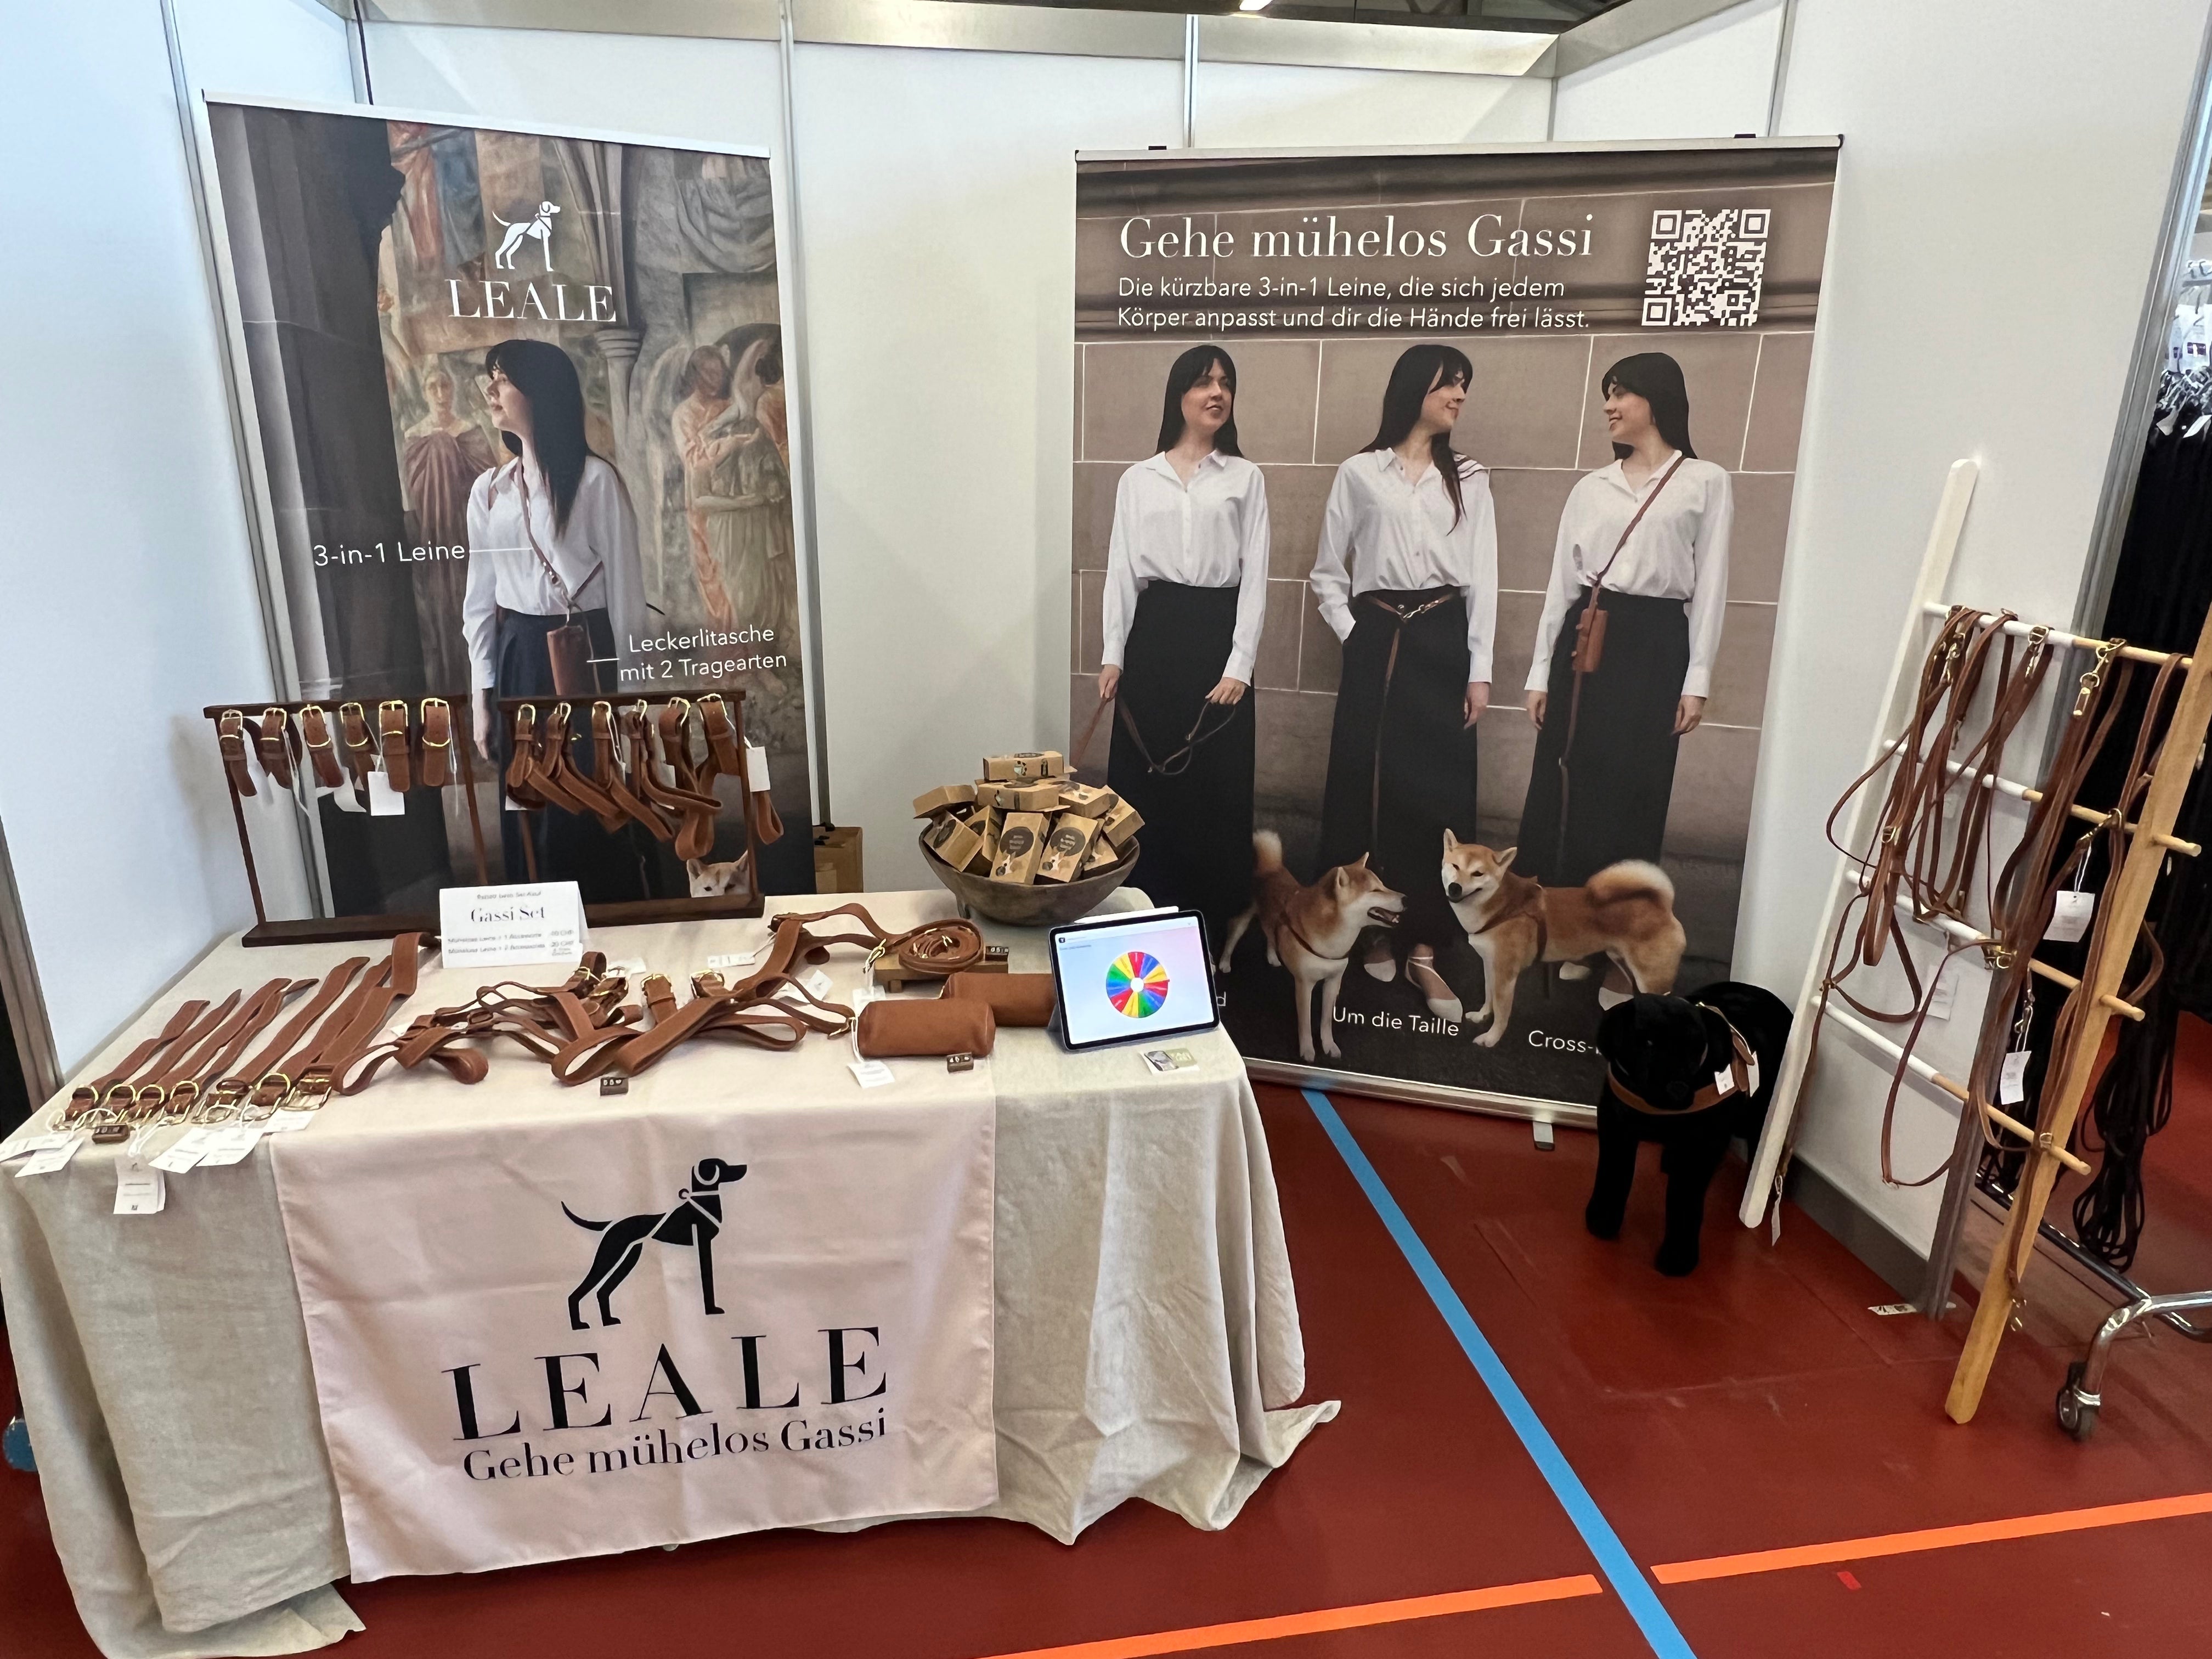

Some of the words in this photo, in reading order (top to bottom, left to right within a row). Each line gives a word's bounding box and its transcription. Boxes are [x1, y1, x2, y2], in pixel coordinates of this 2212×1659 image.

[1120, 217, 1234, 258] Gehe
[1250, 215, 1447, 258] mühelos
[1468, 213, 1594, 257] Gassi
[444, 279, 617, 322] LEALE
[1119, 276, 1153, 296] Die
[1161, 276, 1251, 297] kürzbare
[1259, 276, 1317, 297] 3-in-1
[1328, 276, 1392, 300] Leine,
[1399, 275, 1434, 297] die
[1441, 276, 1484, 297] sich
[1489, 275, 1565, 303] jedem
[1118, 307, 1189, 331] Körper
[1195, 309, 1277, 332] anpasst
[1283, 306, 1324, 327] und
[1331, 306, 1363, 328] dir
[1367, 306, 1402, 328] die
[1410, 307, 1484, 328] Hände
[1490, 306, 1527, 328] frei
[1535, 307, 1590, 328] lässt.
[313, 542, 385, 566] 3-in-1
[398, 540, 465, 562] Leine
[629, 624, 774, 653] Leckerlitasche
[620, 663, 655, 681] mit
[660, 659, 673, 679] 2
[678, 654, 787, 679] Tragearten
[471, 906, 514, 922] Gassi
[520, 905, 545, 920] Set
[1333, 1006, 1364, 1025] Um
[1372, 1011, 1403, 1030] die
[1408, 1015, 1459, 1036] Taille
[441, 1327, 887, 1441] LEALE
[464, 1442, 575, 1480] Gehe
[587, 1423, 769, 1474] mühelos
[781, 1407, 885, 1452] Gassi
